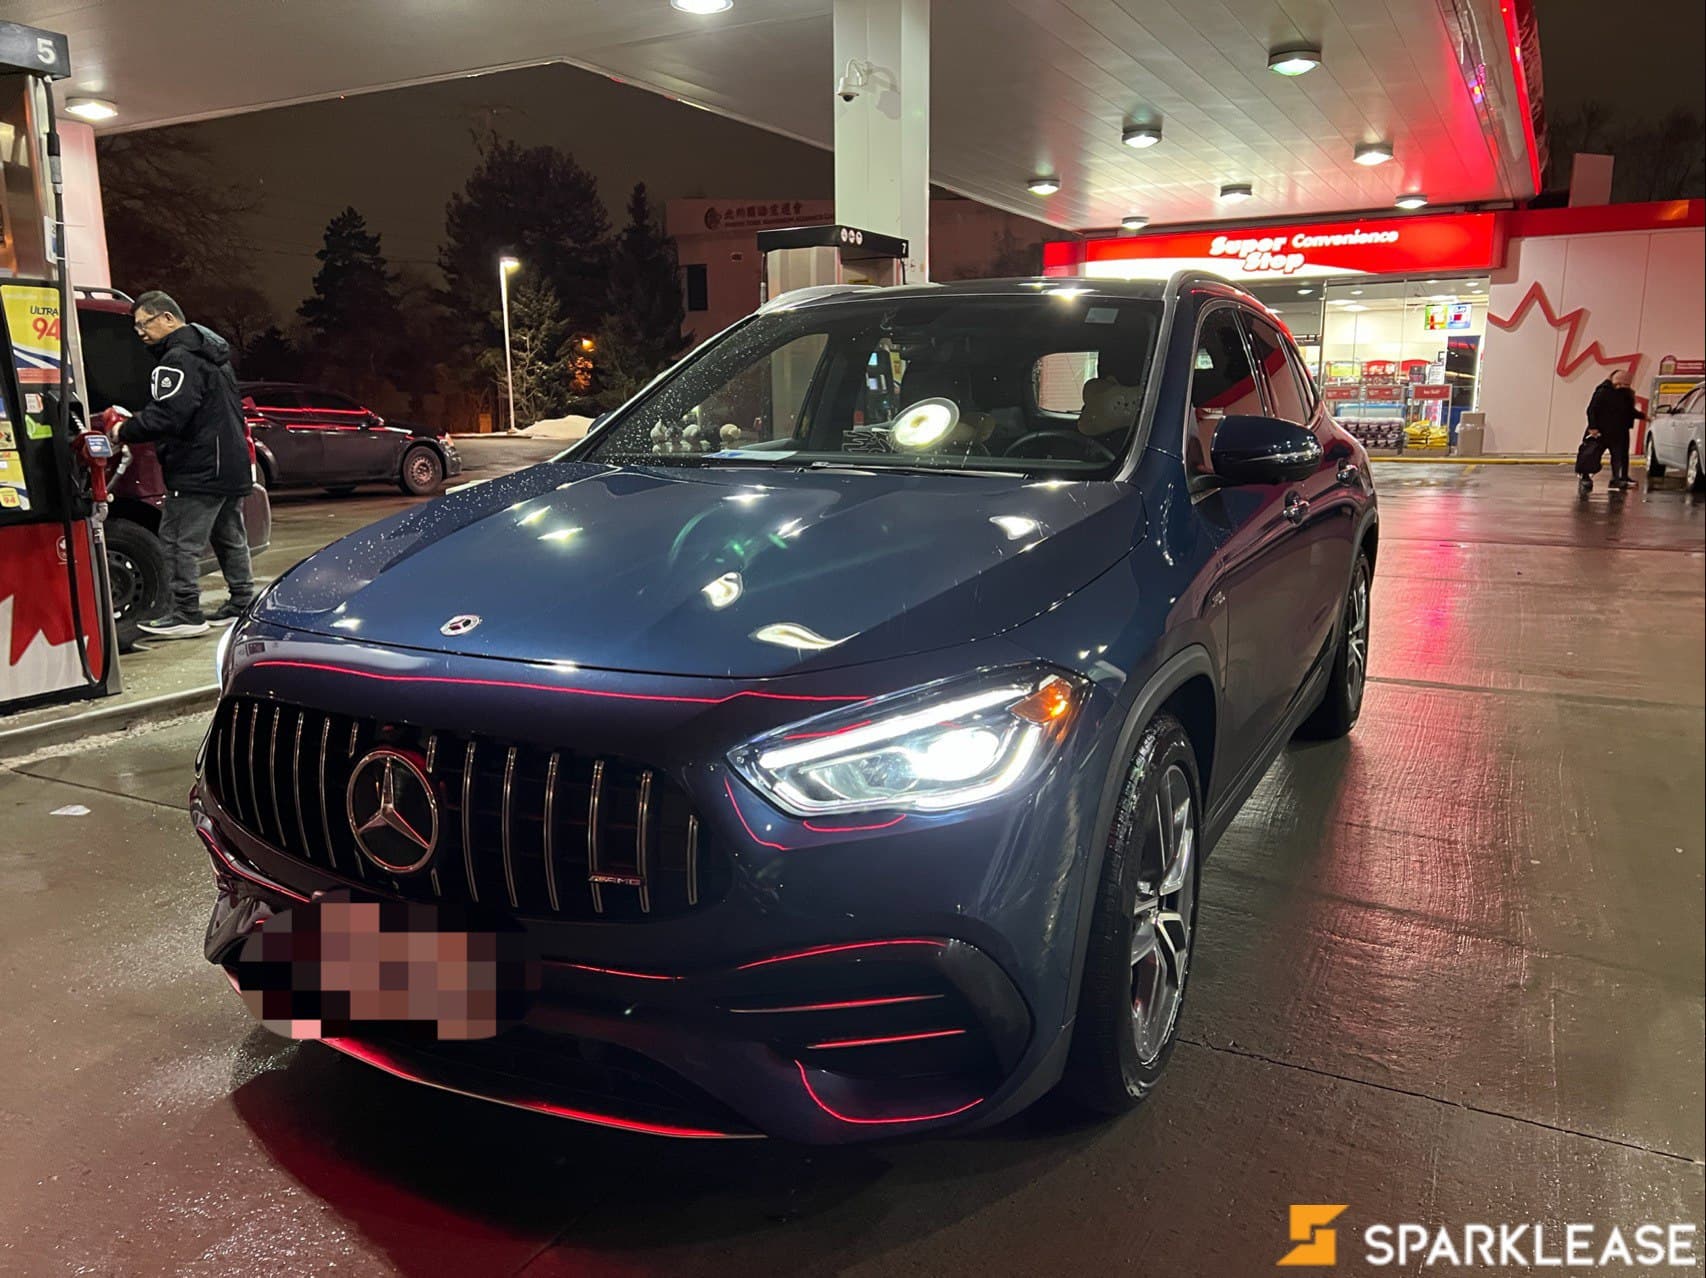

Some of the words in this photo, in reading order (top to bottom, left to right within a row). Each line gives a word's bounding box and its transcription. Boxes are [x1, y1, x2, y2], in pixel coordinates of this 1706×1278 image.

[36, 37, 56, 64] 5
[1209, 235, 1287, 257] Super
[1291, 229, 1399, 248] Convenience
[1242, 251, 1305, 274] Stop
[30, 305, 59, 316] ULTRA
[31, 316, 62, 341] 94
